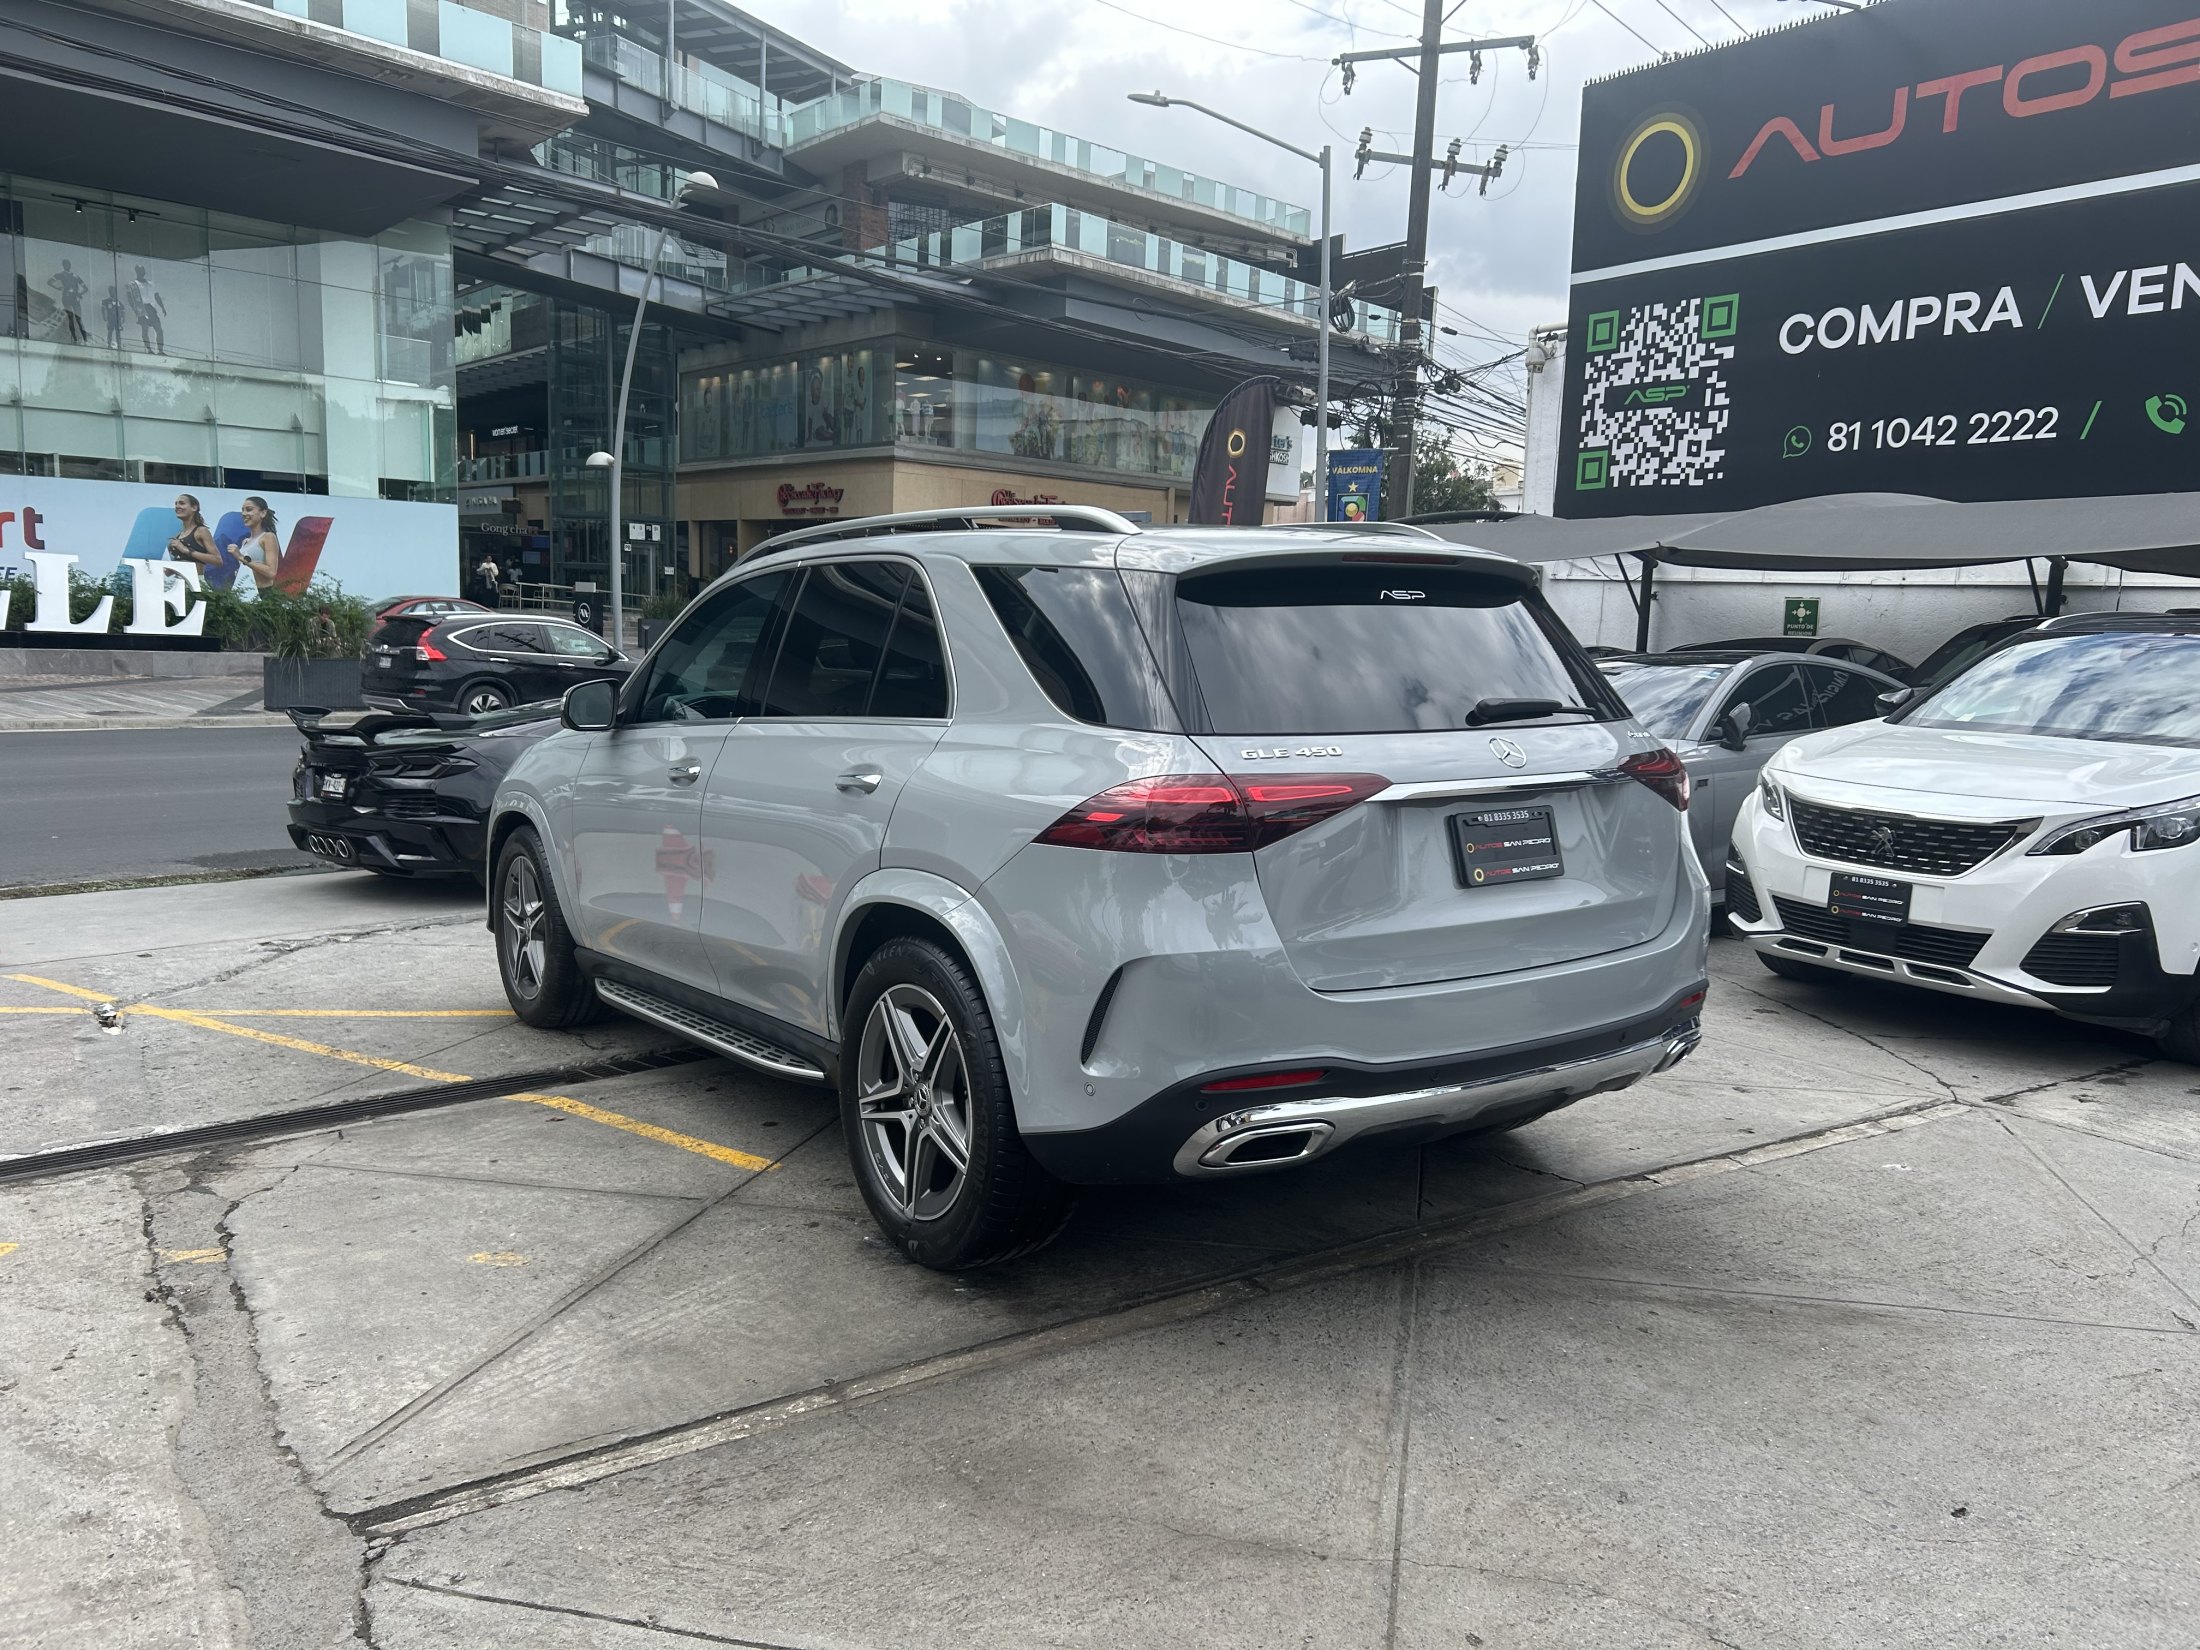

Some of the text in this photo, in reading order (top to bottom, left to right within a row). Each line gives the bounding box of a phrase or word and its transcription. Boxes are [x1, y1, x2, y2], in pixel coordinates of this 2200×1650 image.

[1727, 18, 2200, 180] AUTOS
[1778, 286, 2024, 356] COMPRA
[1624, 386, 1687, 405] ASP
[1826, 421, 1861, 453] 81
[1871, 415, 1958, 450] 1042
[1966, 406, 2060, 445] 2222
[481, 522, 508, 536] Gong
[0, 552, 207, 636] LE
[1240, 746, 1343, 760] GLE 450
[1484, 810, 1529, 822] 81 8335 3535
[1474, 837, 1552, 850] AUTOS SAN PEDRO
[1485, 862, 1560, 876] AUTOS SAN PEDRO
[1860, 877, 1874, 885] 8335
